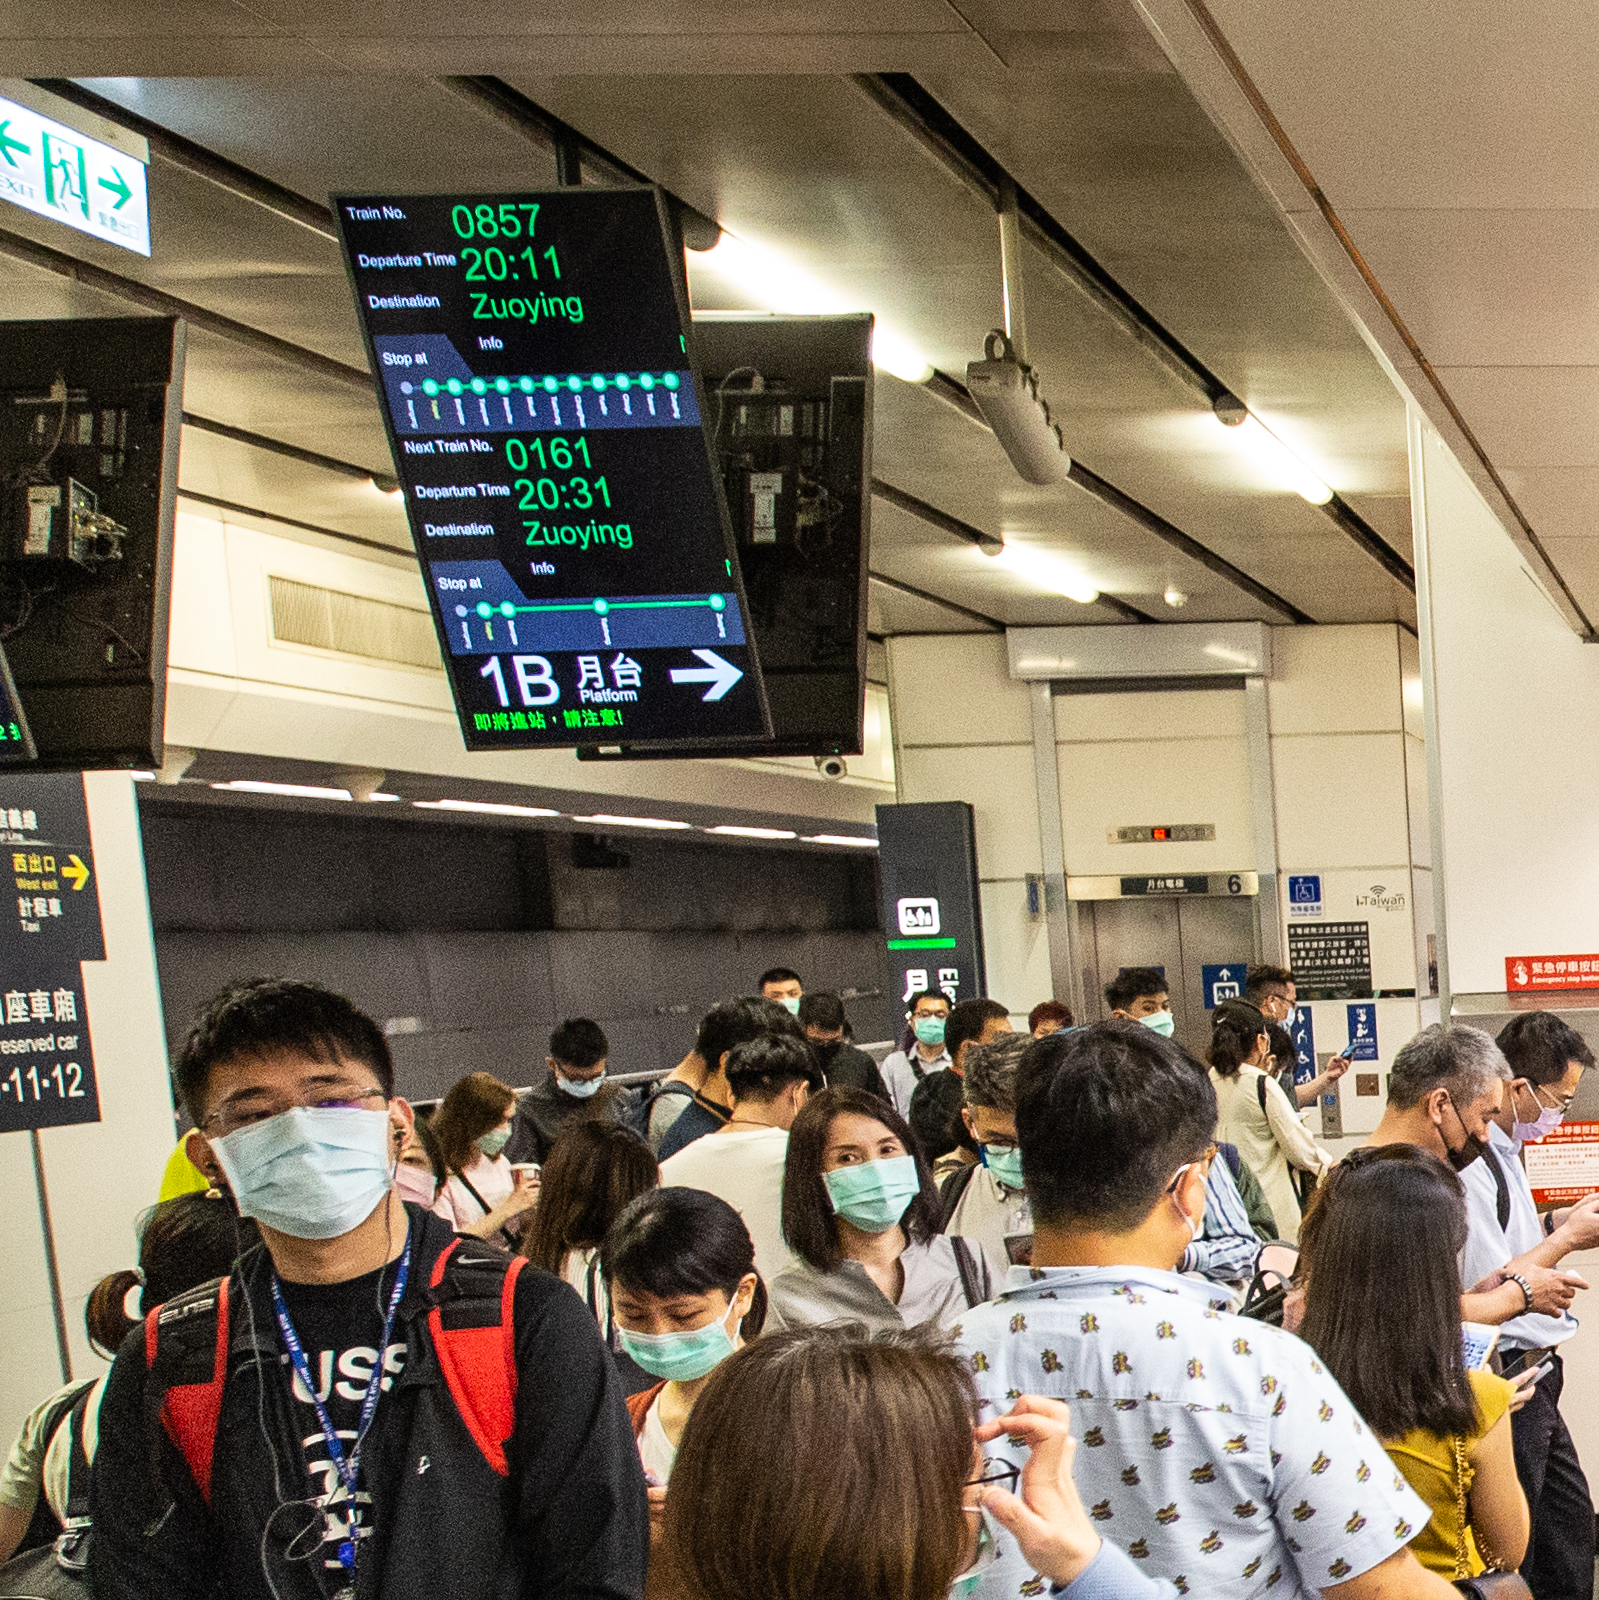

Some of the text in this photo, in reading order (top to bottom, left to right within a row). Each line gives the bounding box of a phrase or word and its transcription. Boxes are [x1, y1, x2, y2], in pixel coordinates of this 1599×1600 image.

[346, 206, 406, 220] Train No.
[452, 203, 541, 240] 0857
[358, 252, 457, 270] Departure Time
[460, 245, 562, 282] 20:11
[368, 294, 441, 309] Destination
[470, 291, 584, 325] Zuoying
[478, 335, 503, 350] Info
[382, 351, 428, 368] Stop at
[404, 438, 494, 454] Next Train No.
[505, 435, 592, 472] 0161
[415, 483, 511, 500] Departure Time
[513, 475, 613, 511] 20:31
[425, 523, 494, 538] Destination
[523, 519, 634, 550] Zuoying
[530, 561, 555, 575] Info
[438, 576, 483, 593] Stop at
[576, 651, 643, 690] 月台
[480, 653, 561, 708] 1B
[579, 687, 638, 704] Platform
[1227, 874, 1242, 894] 6
[0, 986, 77, 1024] 座車廂
[57, 1033, 79, 1052] car
